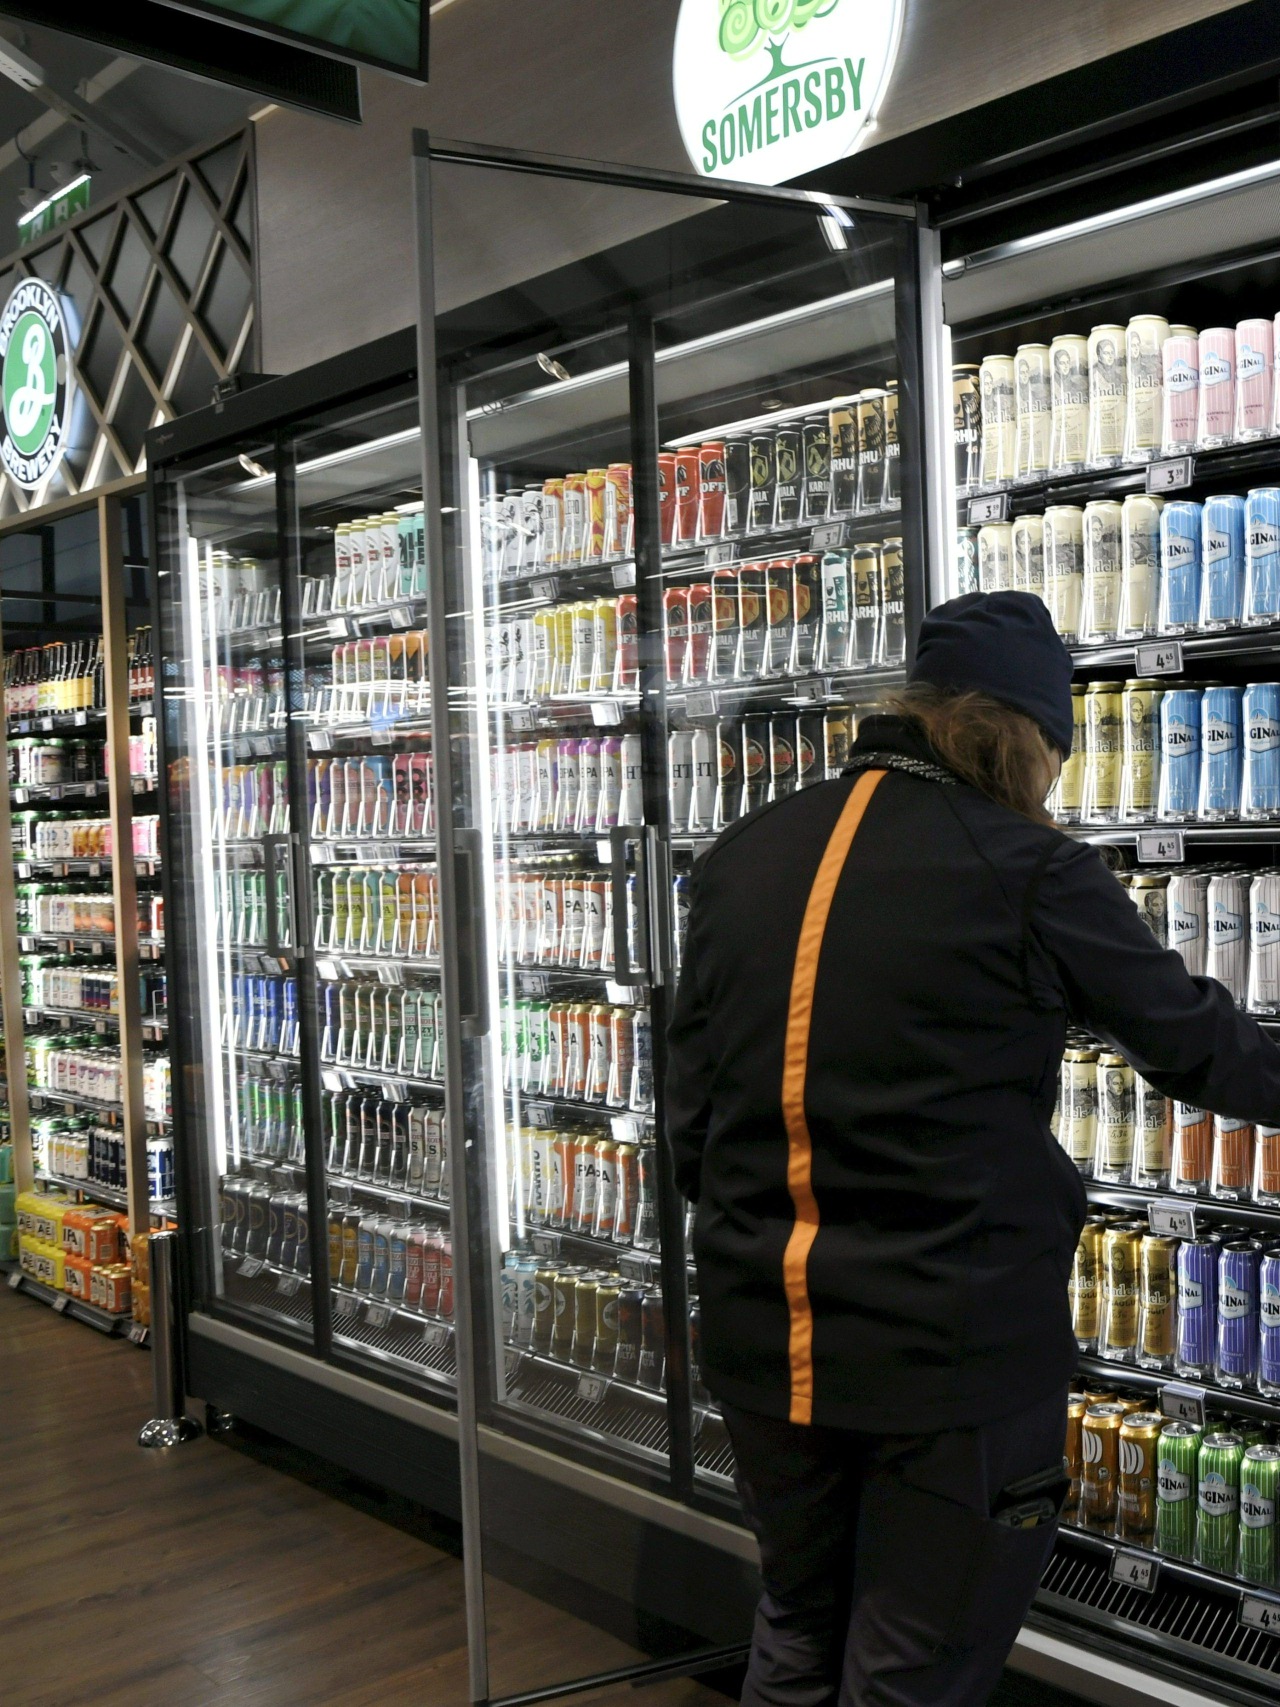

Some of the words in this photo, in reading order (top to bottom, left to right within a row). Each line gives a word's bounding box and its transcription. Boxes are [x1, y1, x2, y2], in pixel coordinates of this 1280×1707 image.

[702, 58, 865, 173] SOMERSBY
[3, 413, 61, 481] BREWERY
[700, 481, 726, 493] OFF
